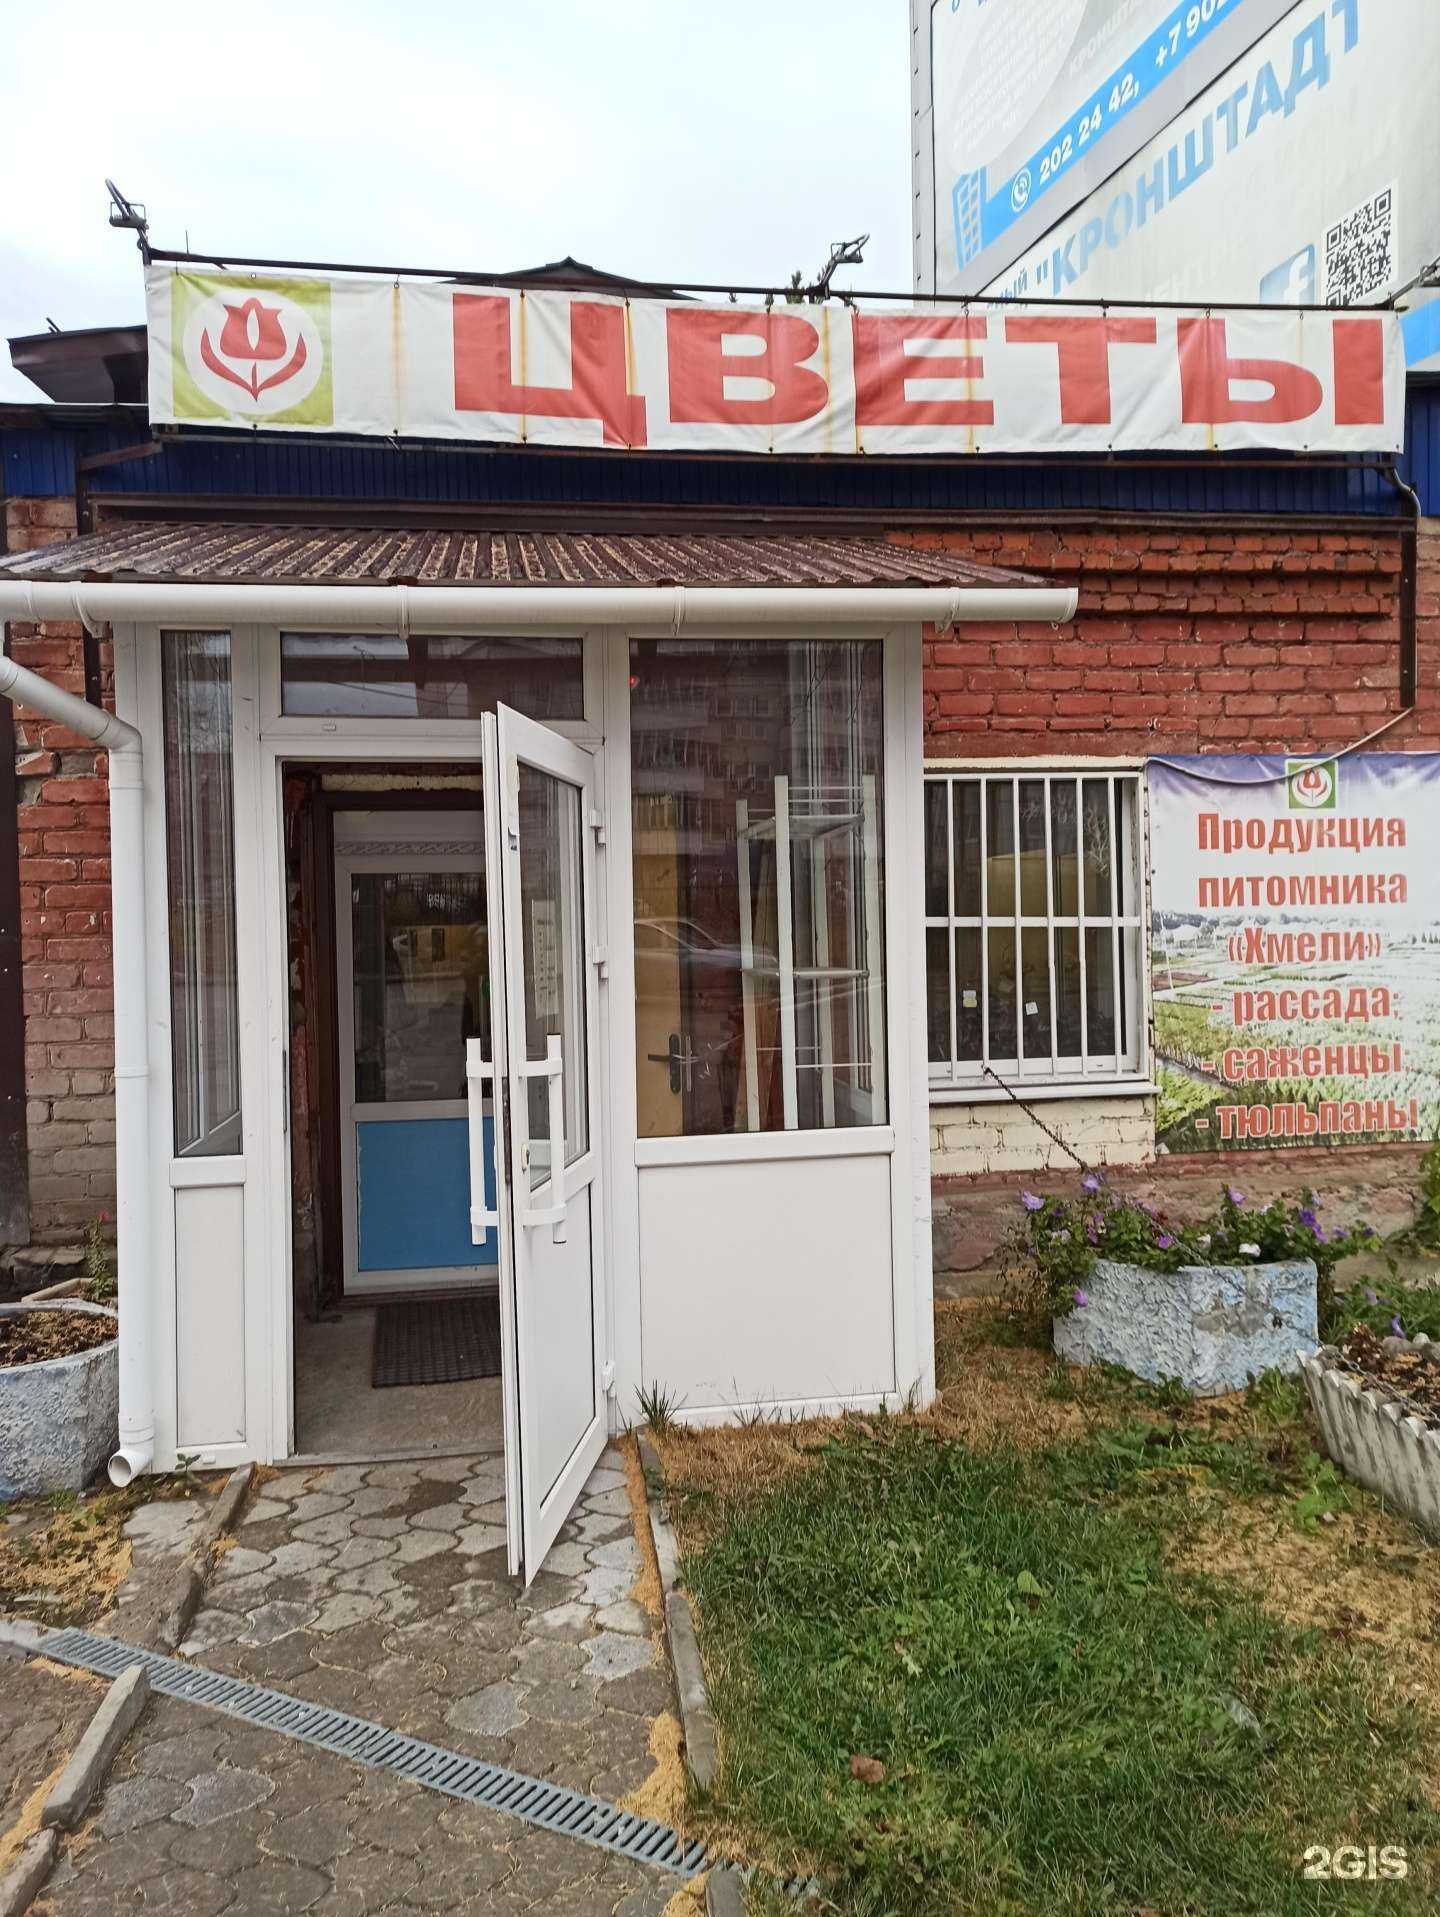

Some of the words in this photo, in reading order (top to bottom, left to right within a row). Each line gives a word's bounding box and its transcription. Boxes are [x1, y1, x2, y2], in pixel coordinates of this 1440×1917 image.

[1039, 133, 1074, 186] 202
[1077, 103, 1103, 147] 24
[1107, 72, 1140, 113] 42,
[1154, 20, 1182, 68] +7
[452, 292, 1384, 446] ЦВЕТЫ
[1197, 812, 1408, 855] Продукция
[1198, 872, 1408, 909] питомника
[1228, 926, 1382, 964] «Хмели»
[1232, 987, 1400, 1026] рассада;
[1216, 1099, 1419, 1139] тюльпаны
